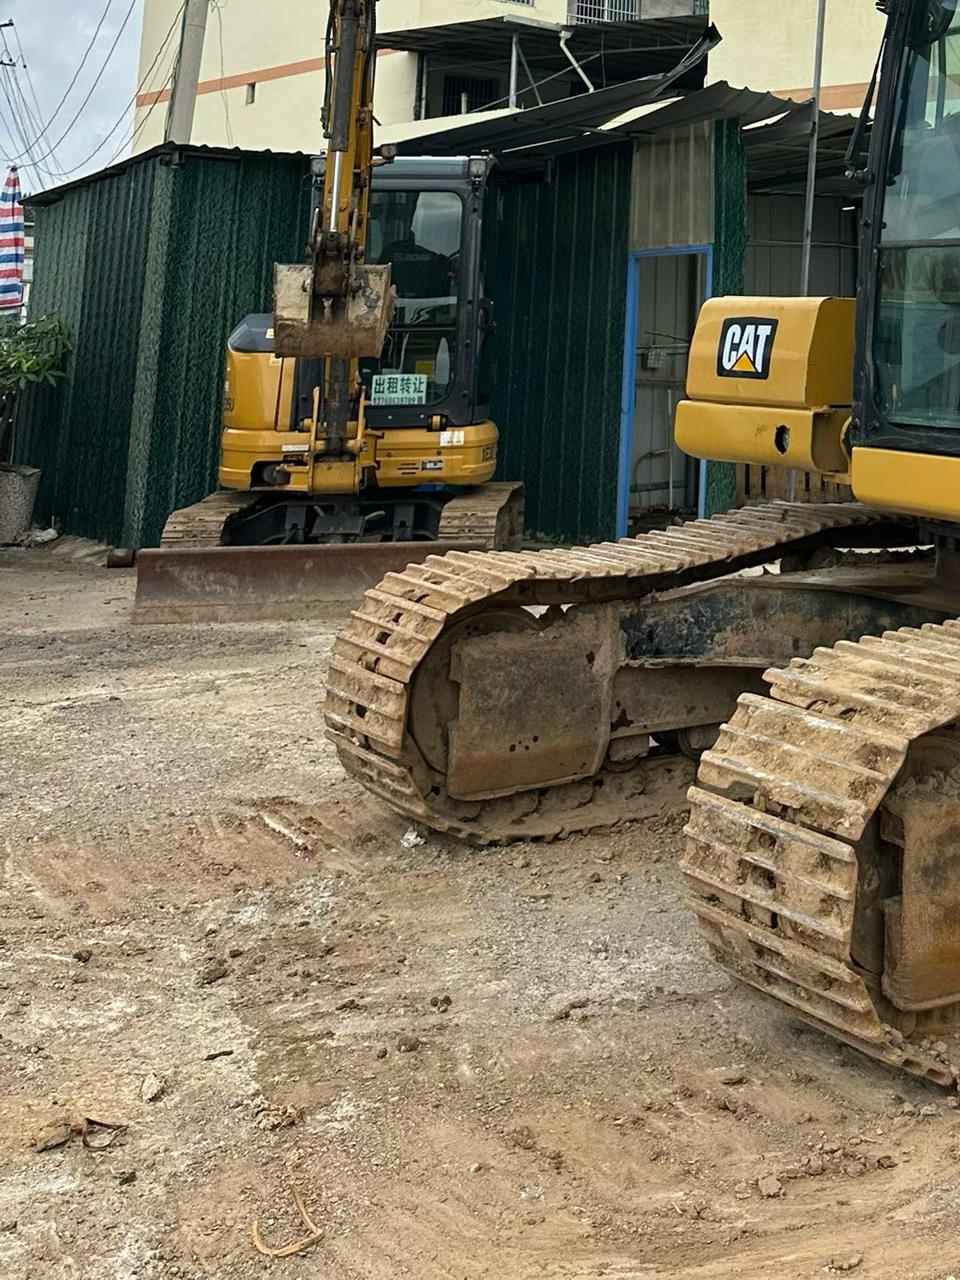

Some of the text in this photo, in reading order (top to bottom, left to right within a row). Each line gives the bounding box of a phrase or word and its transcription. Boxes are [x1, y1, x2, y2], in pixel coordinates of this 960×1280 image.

[722, 324, 772, 373] CAT
[374, 376, 425, 394] 出租转让
